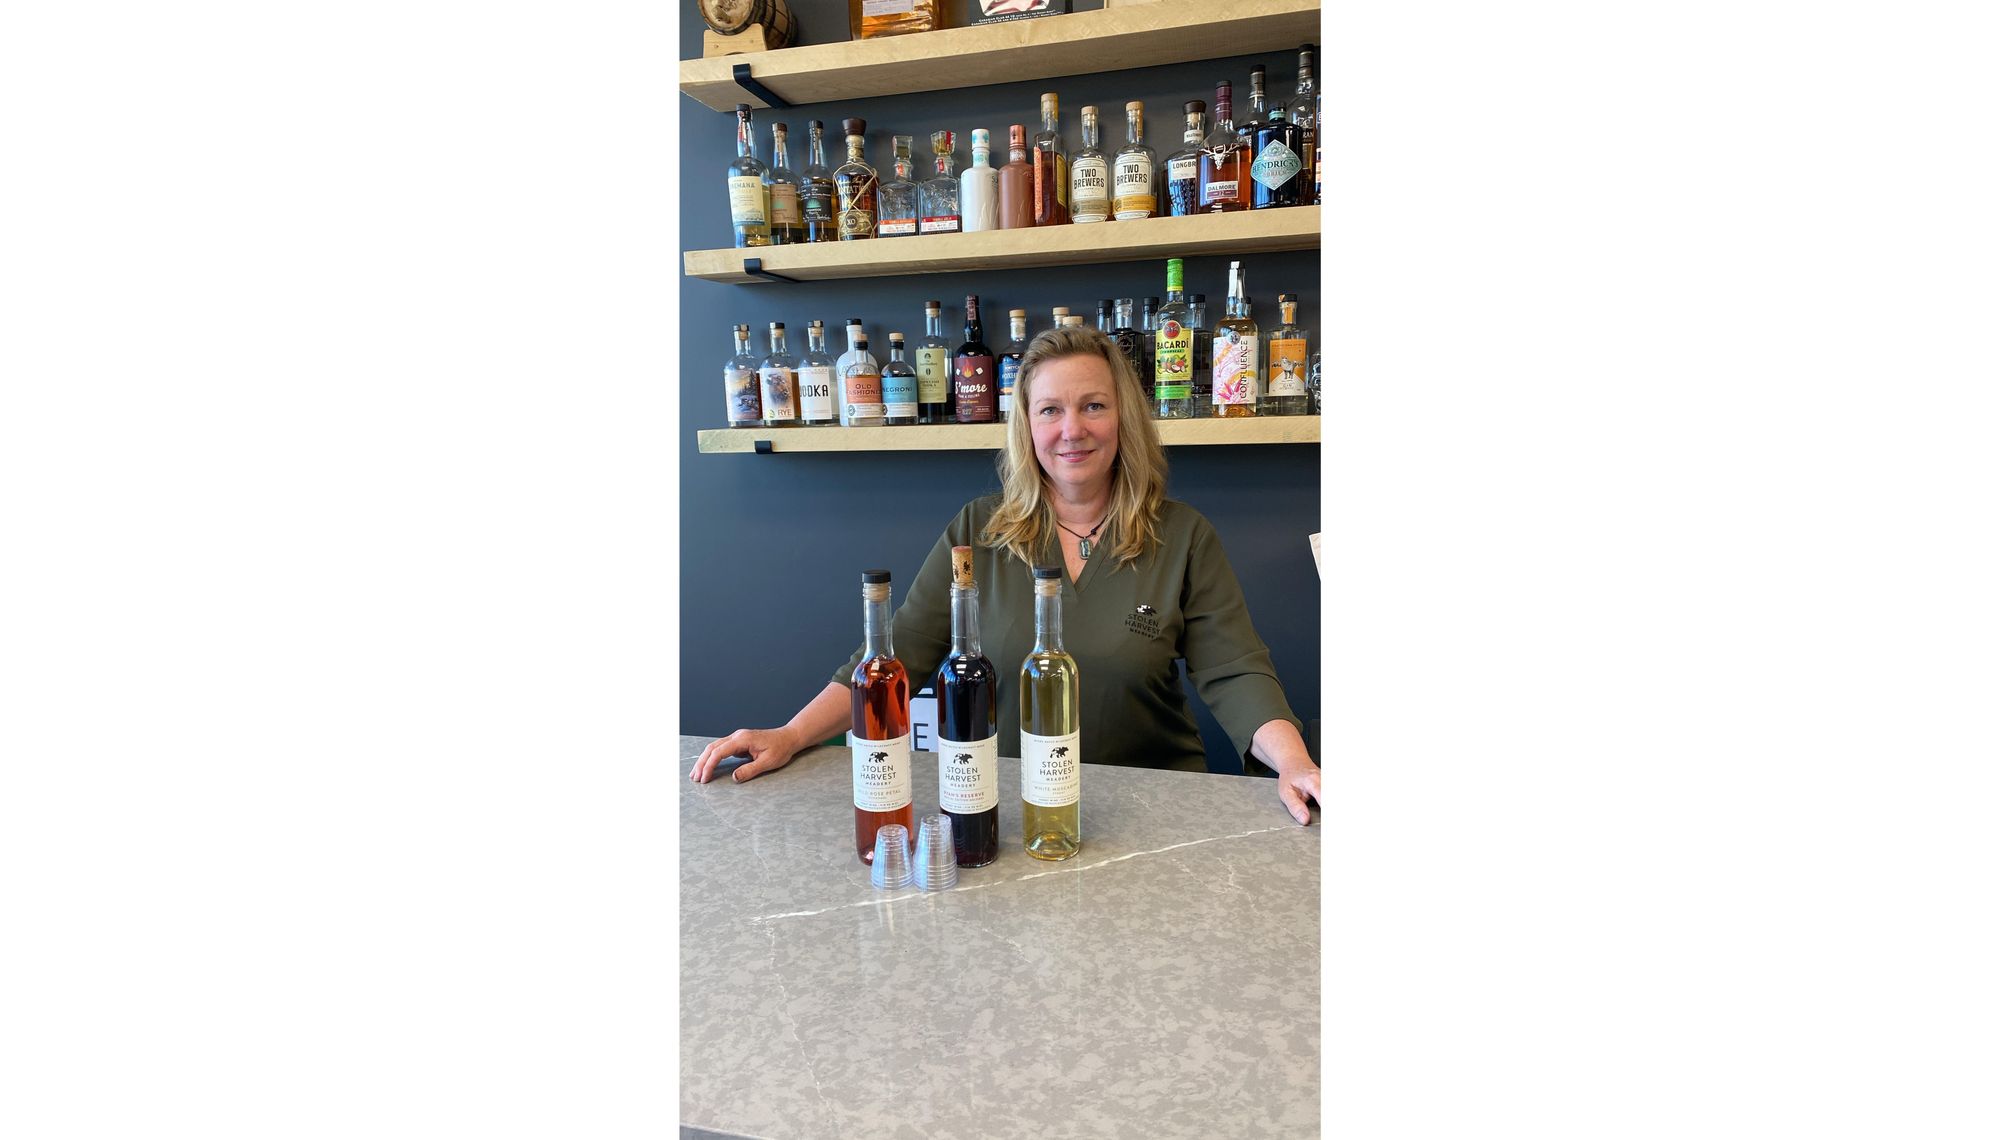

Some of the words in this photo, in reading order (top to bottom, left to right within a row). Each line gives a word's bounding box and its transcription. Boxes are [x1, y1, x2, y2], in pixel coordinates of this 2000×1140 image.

[1123, 164, 1139, 174] TWO
[1172, 160, 1196, 169] LONGBR
[1252, 159, 1299, 174] HENDRICK'S
[1080, 168, 1096, 178] TWO
[1074, 178, 1105, 190] BREWERS
[1116, 174, 1148, 186] BREWERS
[1240, 340, 1248, 399] CONFLUENCE
[955, 381, 988, 394] S'more
[778, 408, 792, 416] RYE
[1128, 613, 1159, 628] STOLEN
[1124, 620, 1160, 635] HARVEST
[1042, 759, 1073, 768] STOLEN
[862, 765, 894, 773] STOLEN
[946, 766, 978, 774] STOLEN
[1039, 766, 1075, 776] HARVEST
[860, 772, 896, 780] HARVEST
[945, 774, 982, 782] HARVEST
